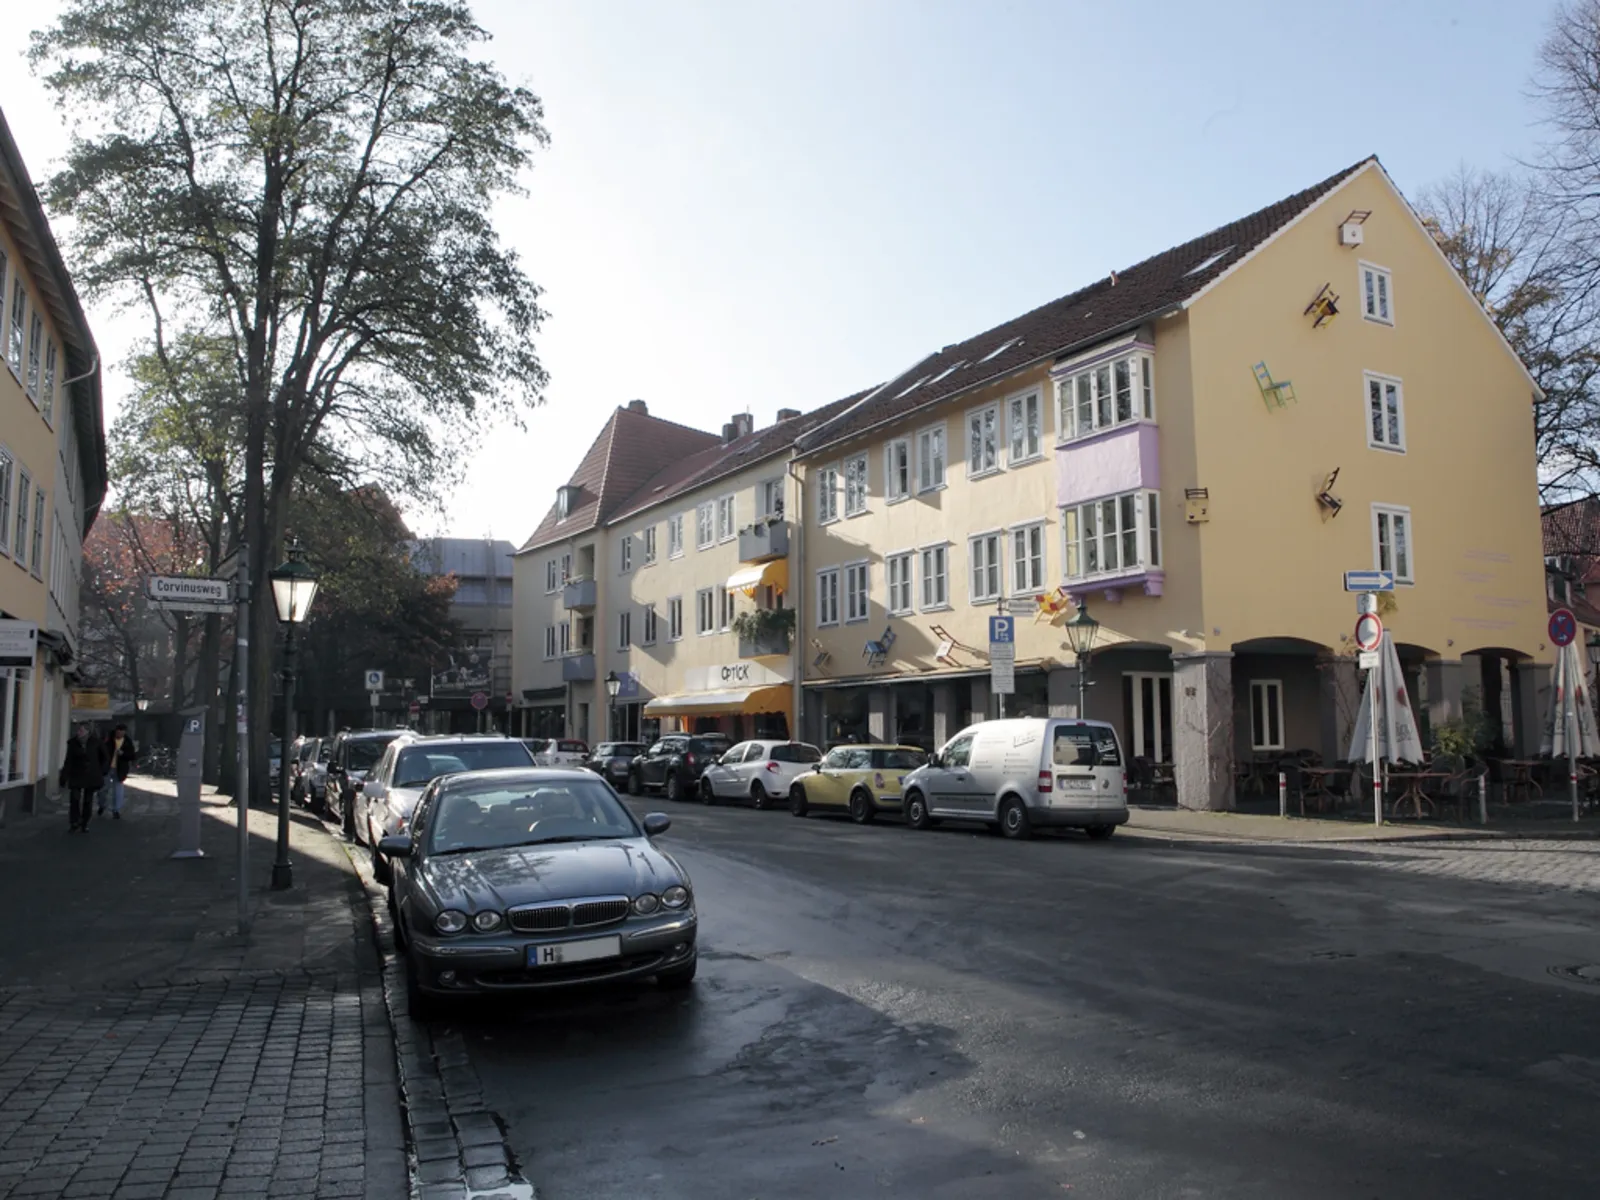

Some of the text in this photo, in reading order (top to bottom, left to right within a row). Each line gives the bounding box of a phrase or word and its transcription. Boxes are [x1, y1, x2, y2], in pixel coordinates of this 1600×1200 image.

[157, 580, 222, 598] Corvinusweg
[994, 619, 1009, 640] P
[190, 719, 199, 732] P
[543, 947, 554, 962] H
